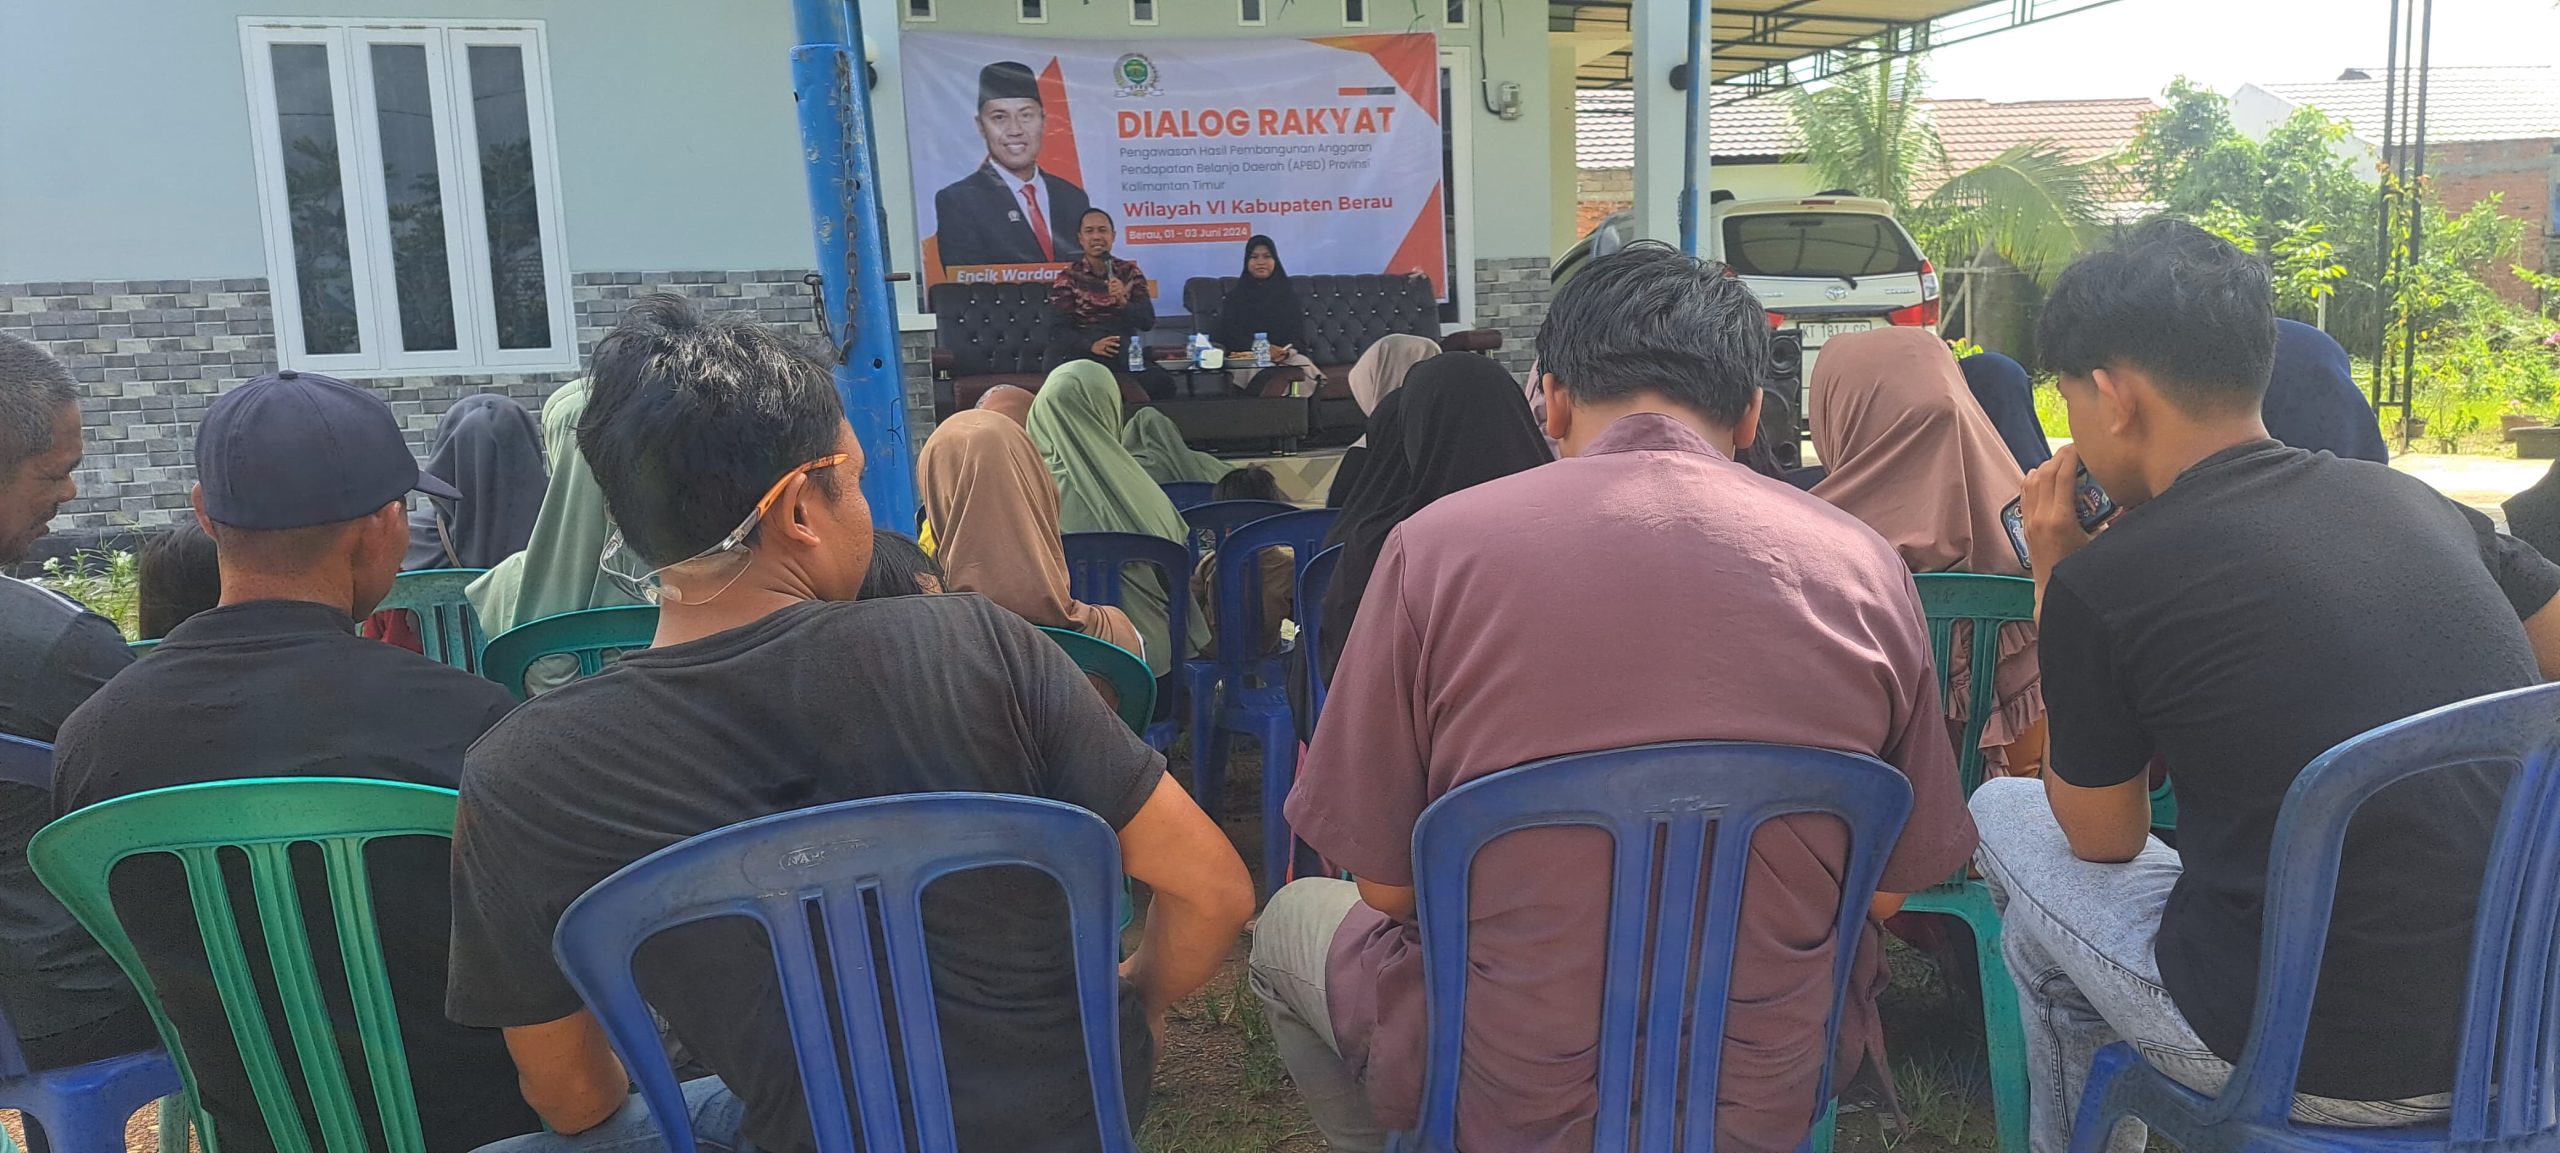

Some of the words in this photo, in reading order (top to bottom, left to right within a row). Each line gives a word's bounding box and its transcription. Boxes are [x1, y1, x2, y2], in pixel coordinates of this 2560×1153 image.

[1117, 109, 1250, 138] DIALOG
[1258, 107, 1395, 136] RAKYAT
[1120, 147, 1196, 160] Pengawasan
[1199, 145, 1227, 156] Hasil
[1229, 144, 1314, 157] Pembangunan
[1318, 143, 1372, 155] Anggaran
[1121, 164, 1194, 176] Pendapatan
[1196, 162, 1240, 175] Belanja
[1242, 161, 1285, 172] Daerah
[1288, 158, 1326, 172] (APBD)
[1329, 158, 1370, 170] Provinsi
[1122, 180, 1190, 192] Kalimantan
[1192, 180, 1225, 191] Timur
[1123, 201, 1201, 219] Wilayah
[1206, 200, 1225, 215] VI
[1231, 198, 1333, 216] Kabupaten
[1338, 196, 1393, 210] Berau
[1129, 229, 1162, 240] Berau,
[1164, 229, 1175, 239] 01
[1184, 228, 1197, 238] 03
[1199, 228, 1221, 238] Juni
[1223, 227, 1248, 237] 2024
[957, 269, 998, 282] Encik
